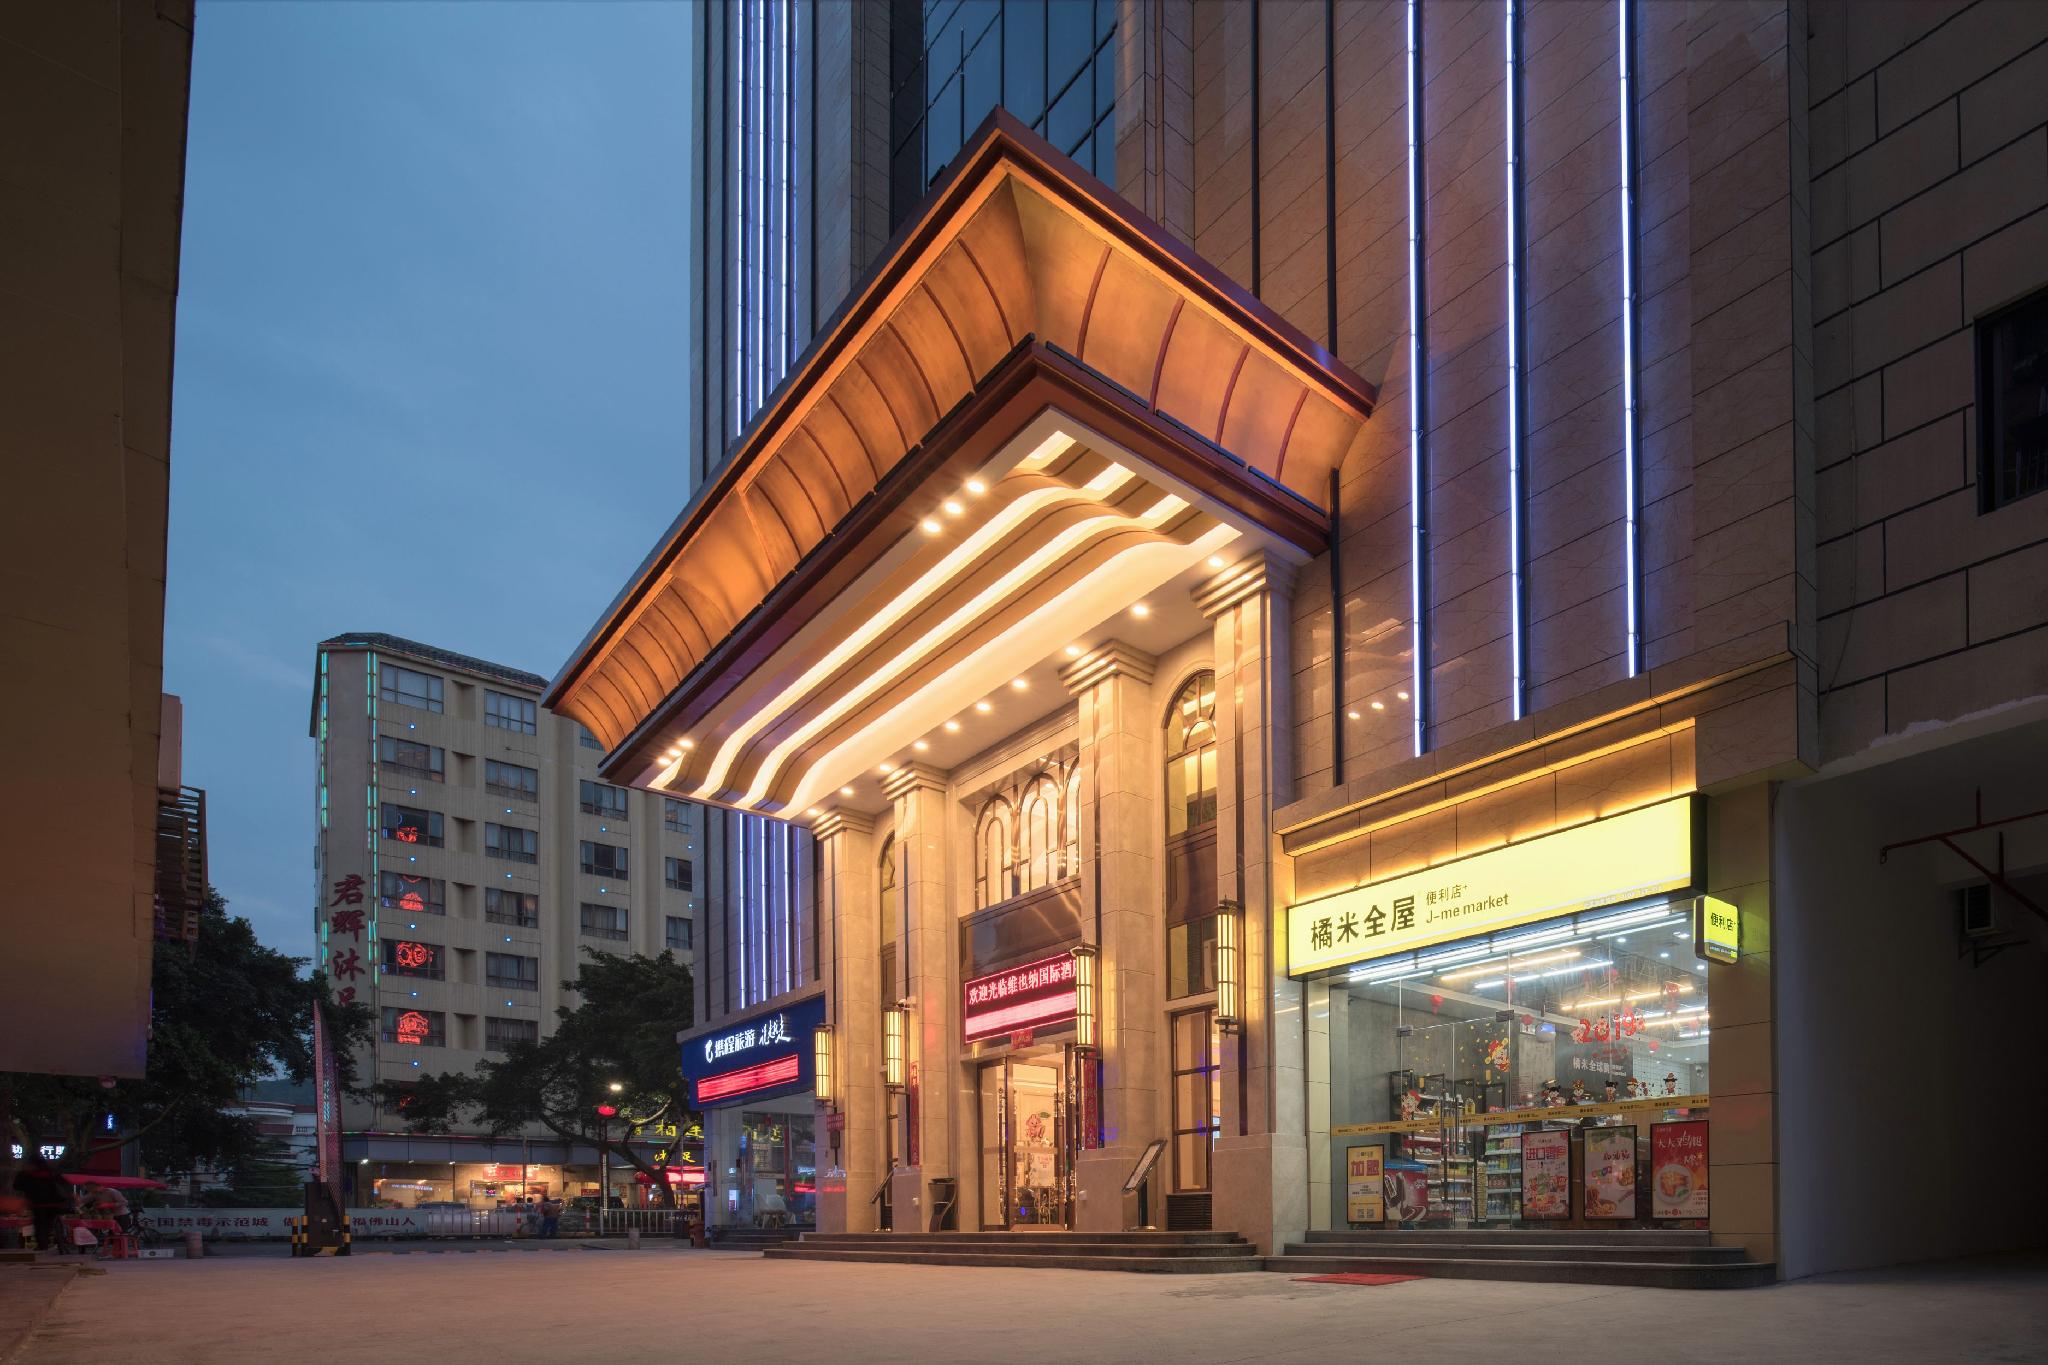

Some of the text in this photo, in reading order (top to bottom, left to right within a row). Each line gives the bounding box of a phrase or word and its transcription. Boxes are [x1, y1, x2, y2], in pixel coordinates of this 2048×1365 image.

[1463, 893, 1509, 916] market
[1311, 895, 1415, 951] 橘米全屋
[714, 1028, 756, 1058] 携程旅游
